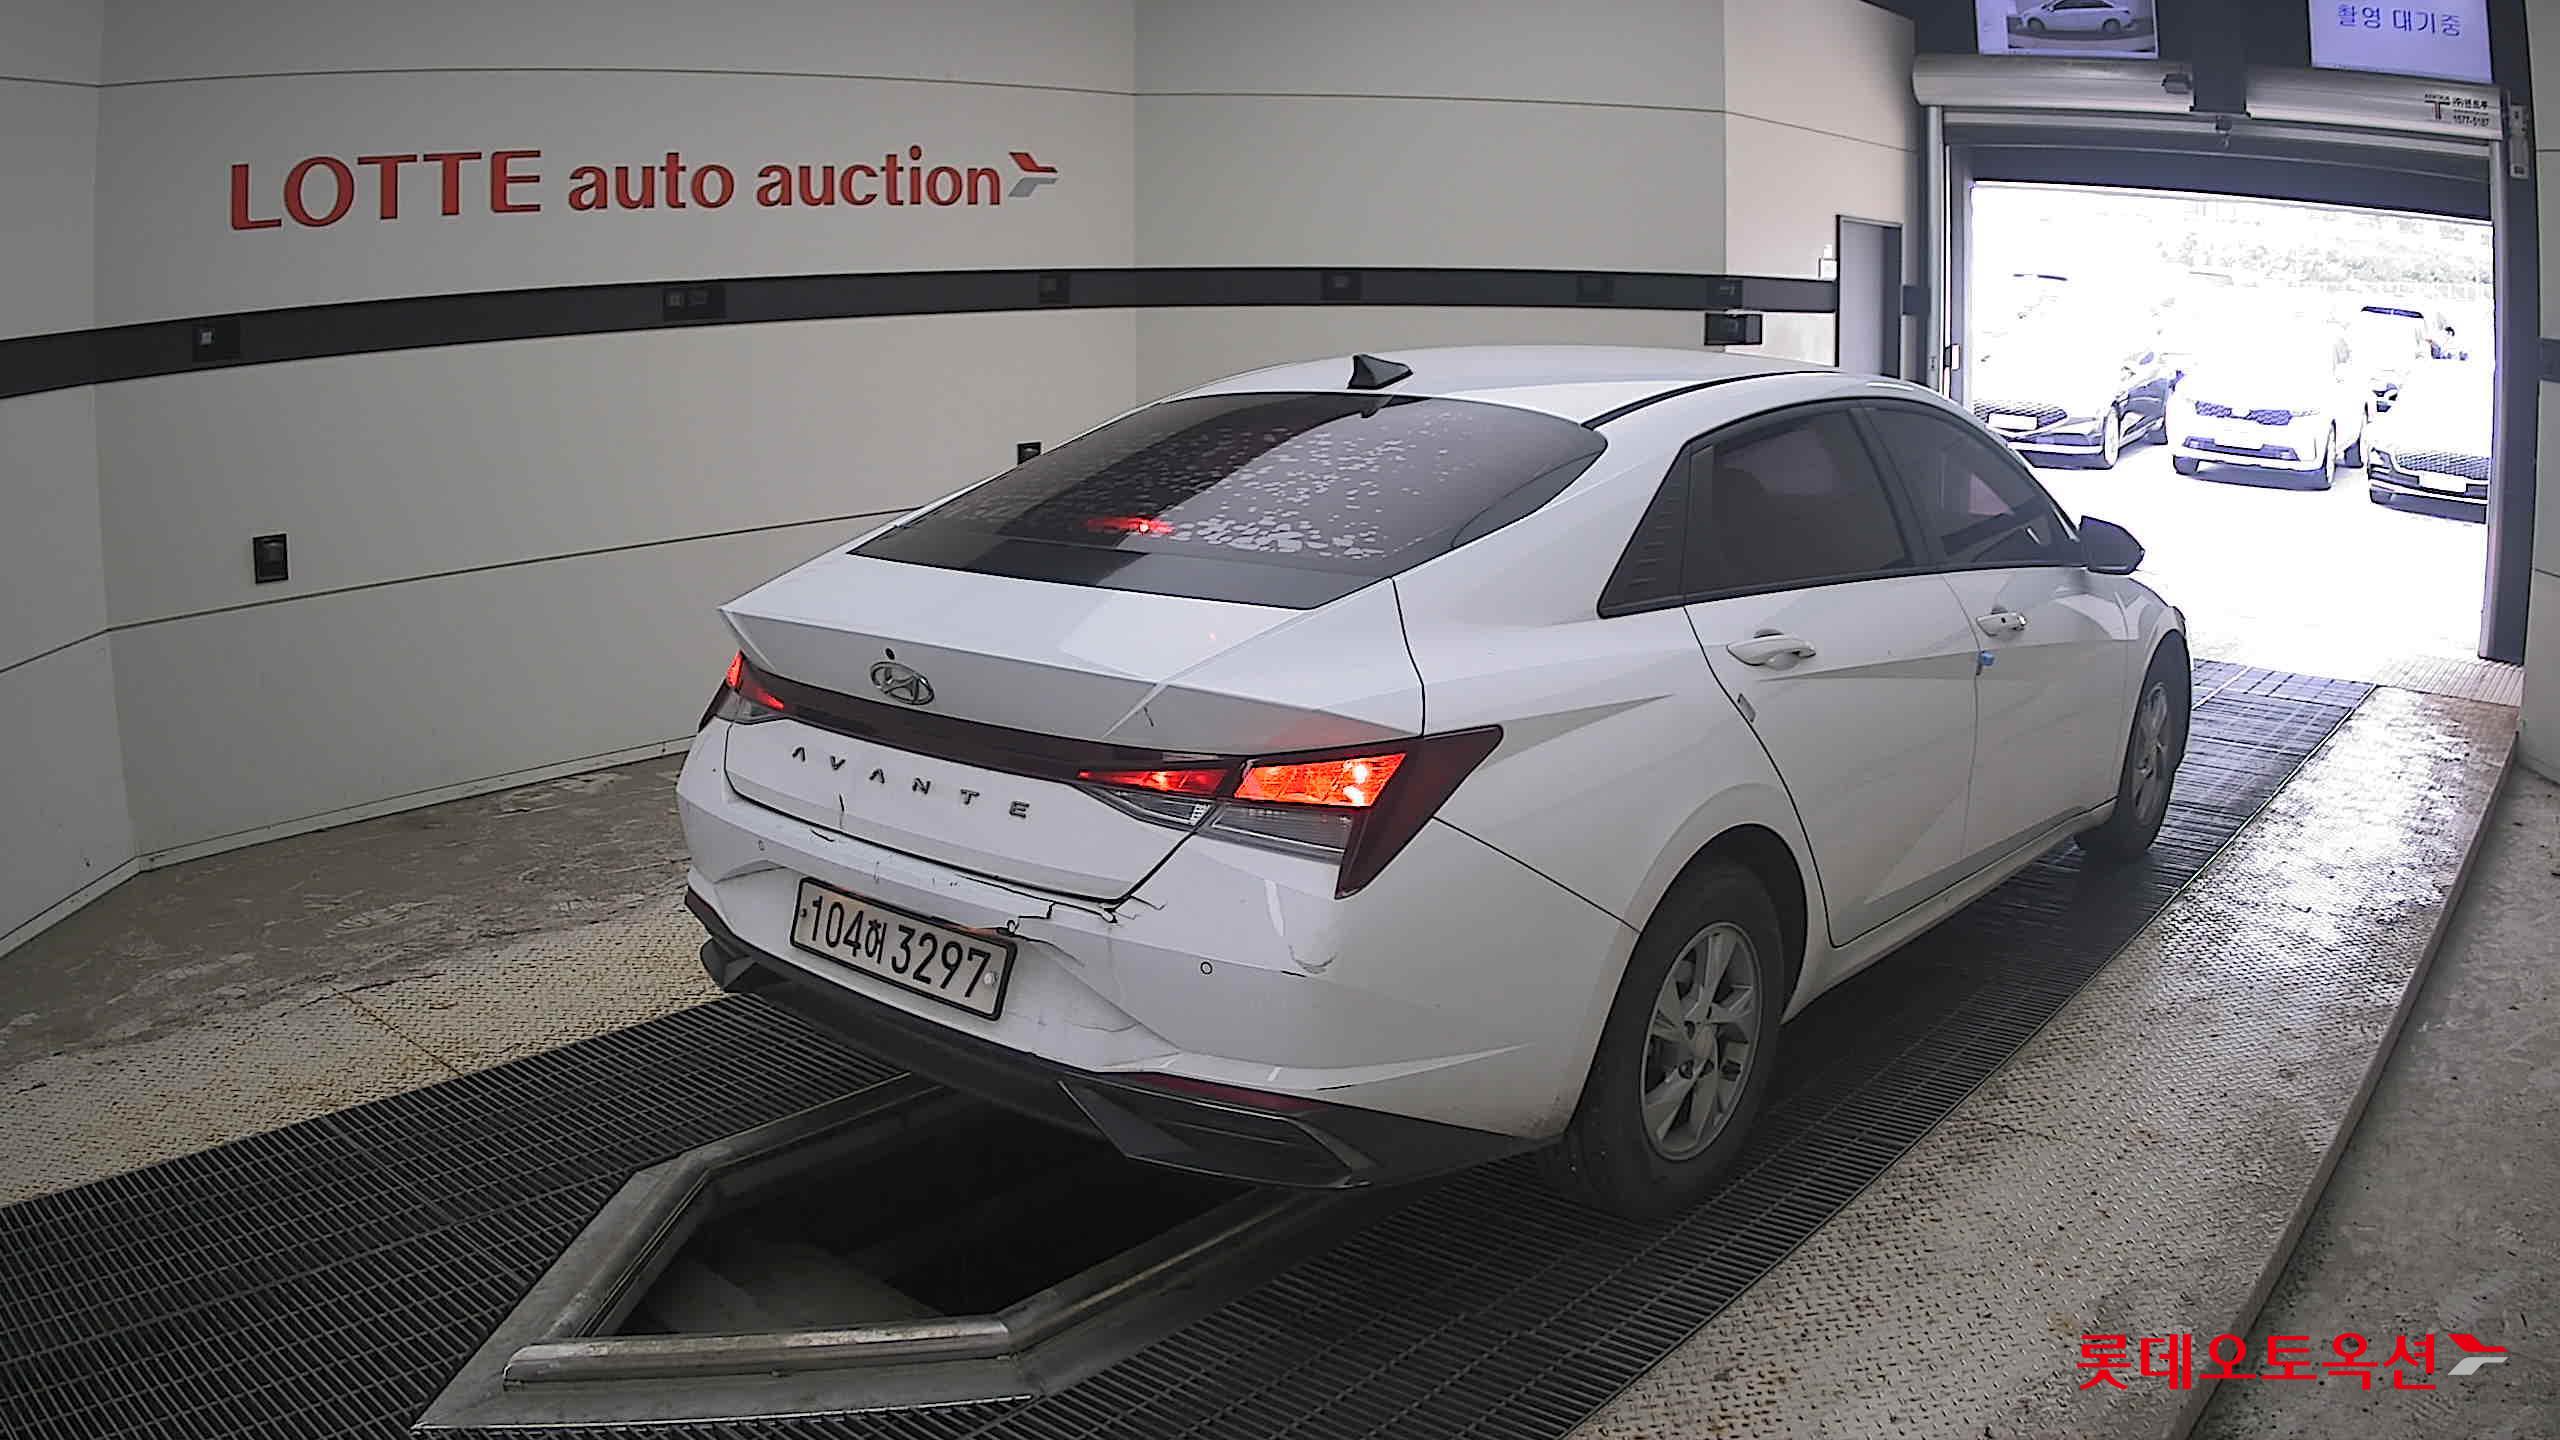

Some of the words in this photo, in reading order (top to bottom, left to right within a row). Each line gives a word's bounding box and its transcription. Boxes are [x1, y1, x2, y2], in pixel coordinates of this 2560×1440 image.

[2338, 5, 2381, 29] 촬영
[2392, 8, 2461, 37] 대기중
[230, 150, 542, 230] LOTTE
[568, 153, 736, 210] auto
[755, 145, 1004, 208] auction
[792, 747, 1030, 818] AVANTE
[891, 924, 992, 998] 3297
